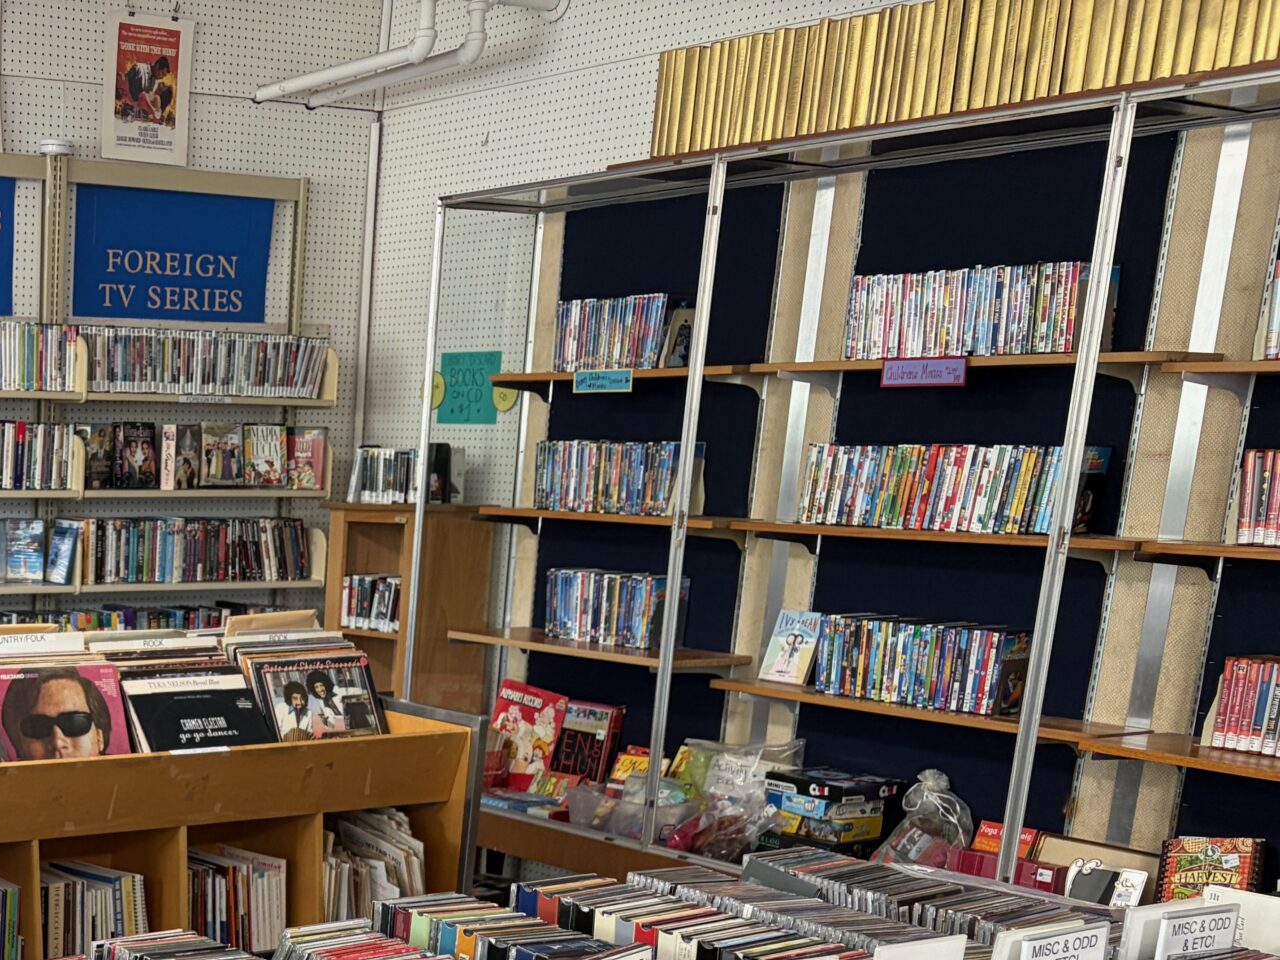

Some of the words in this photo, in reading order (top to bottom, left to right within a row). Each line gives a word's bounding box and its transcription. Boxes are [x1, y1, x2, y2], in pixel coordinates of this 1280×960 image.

[106, 249, 238, 278] FOREIGN
[99, 284, 136, 308] TV
[147, 285, 243, 312] SERIES
[450, 368, 485, 388] BOOKS
[466, 388, 482, 404] CD
[143, 639, 164, 648] ROCK
[179, 731, 191, 743] go
[192, 730, 203, 742] go
[204, 728, 239, 738] dancer
[980, 823, 999, 836] Yoga
[1178, 872, 1237, 884] HARVEST
[1172, 923, 1198, 938] MISC
[1199, 921, 1207, 935] &
[1209, 915, 1231, 932] ODD
[1031, 941, 1061, 960] MISC
[1063, 940, 1071, 954] &
[1075, 934, 1098, 952] ODD
[1183, 937, 1192, 951] &
[1194, 933, 1216, 949] ETC!
